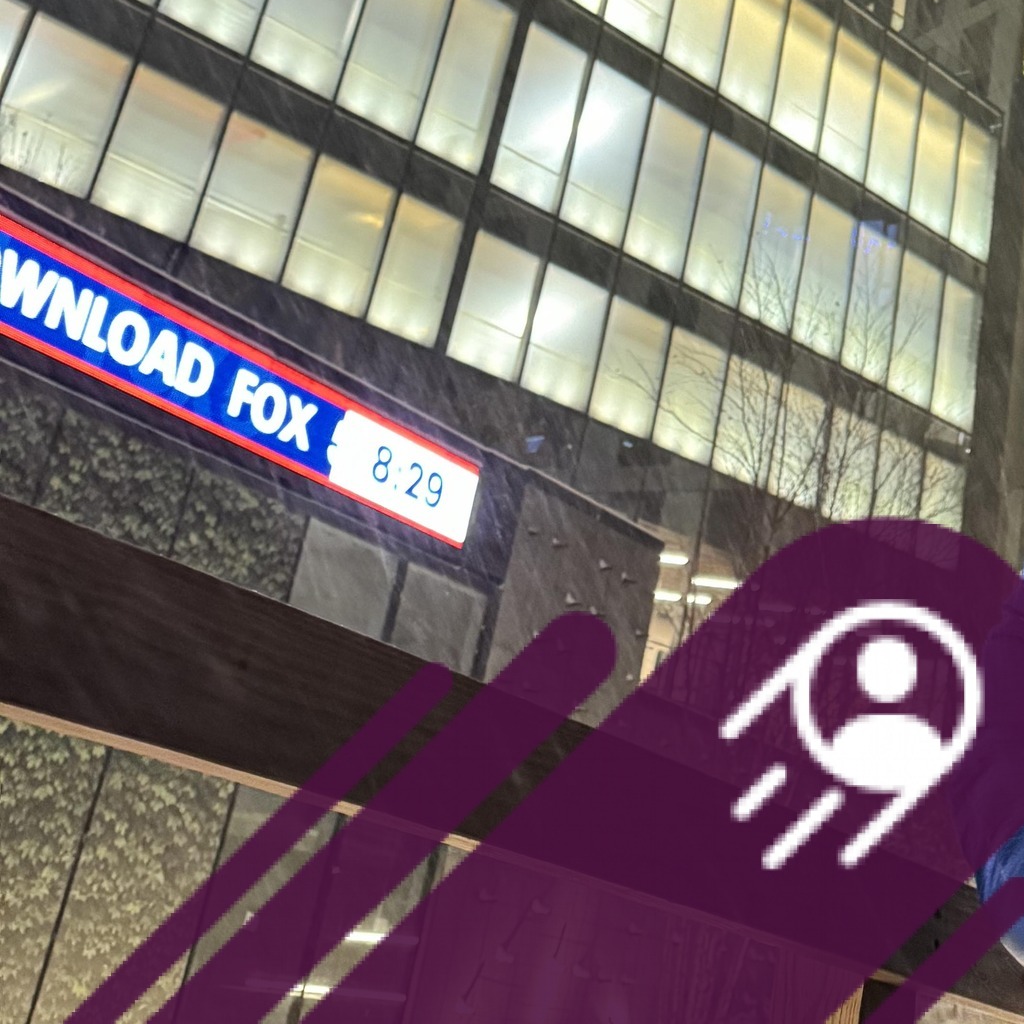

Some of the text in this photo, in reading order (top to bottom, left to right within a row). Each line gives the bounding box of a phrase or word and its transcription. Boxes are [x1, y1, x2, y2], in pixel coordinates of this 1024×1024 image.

[0, 248, 443, 508] WNLOAD FOX 8:29
